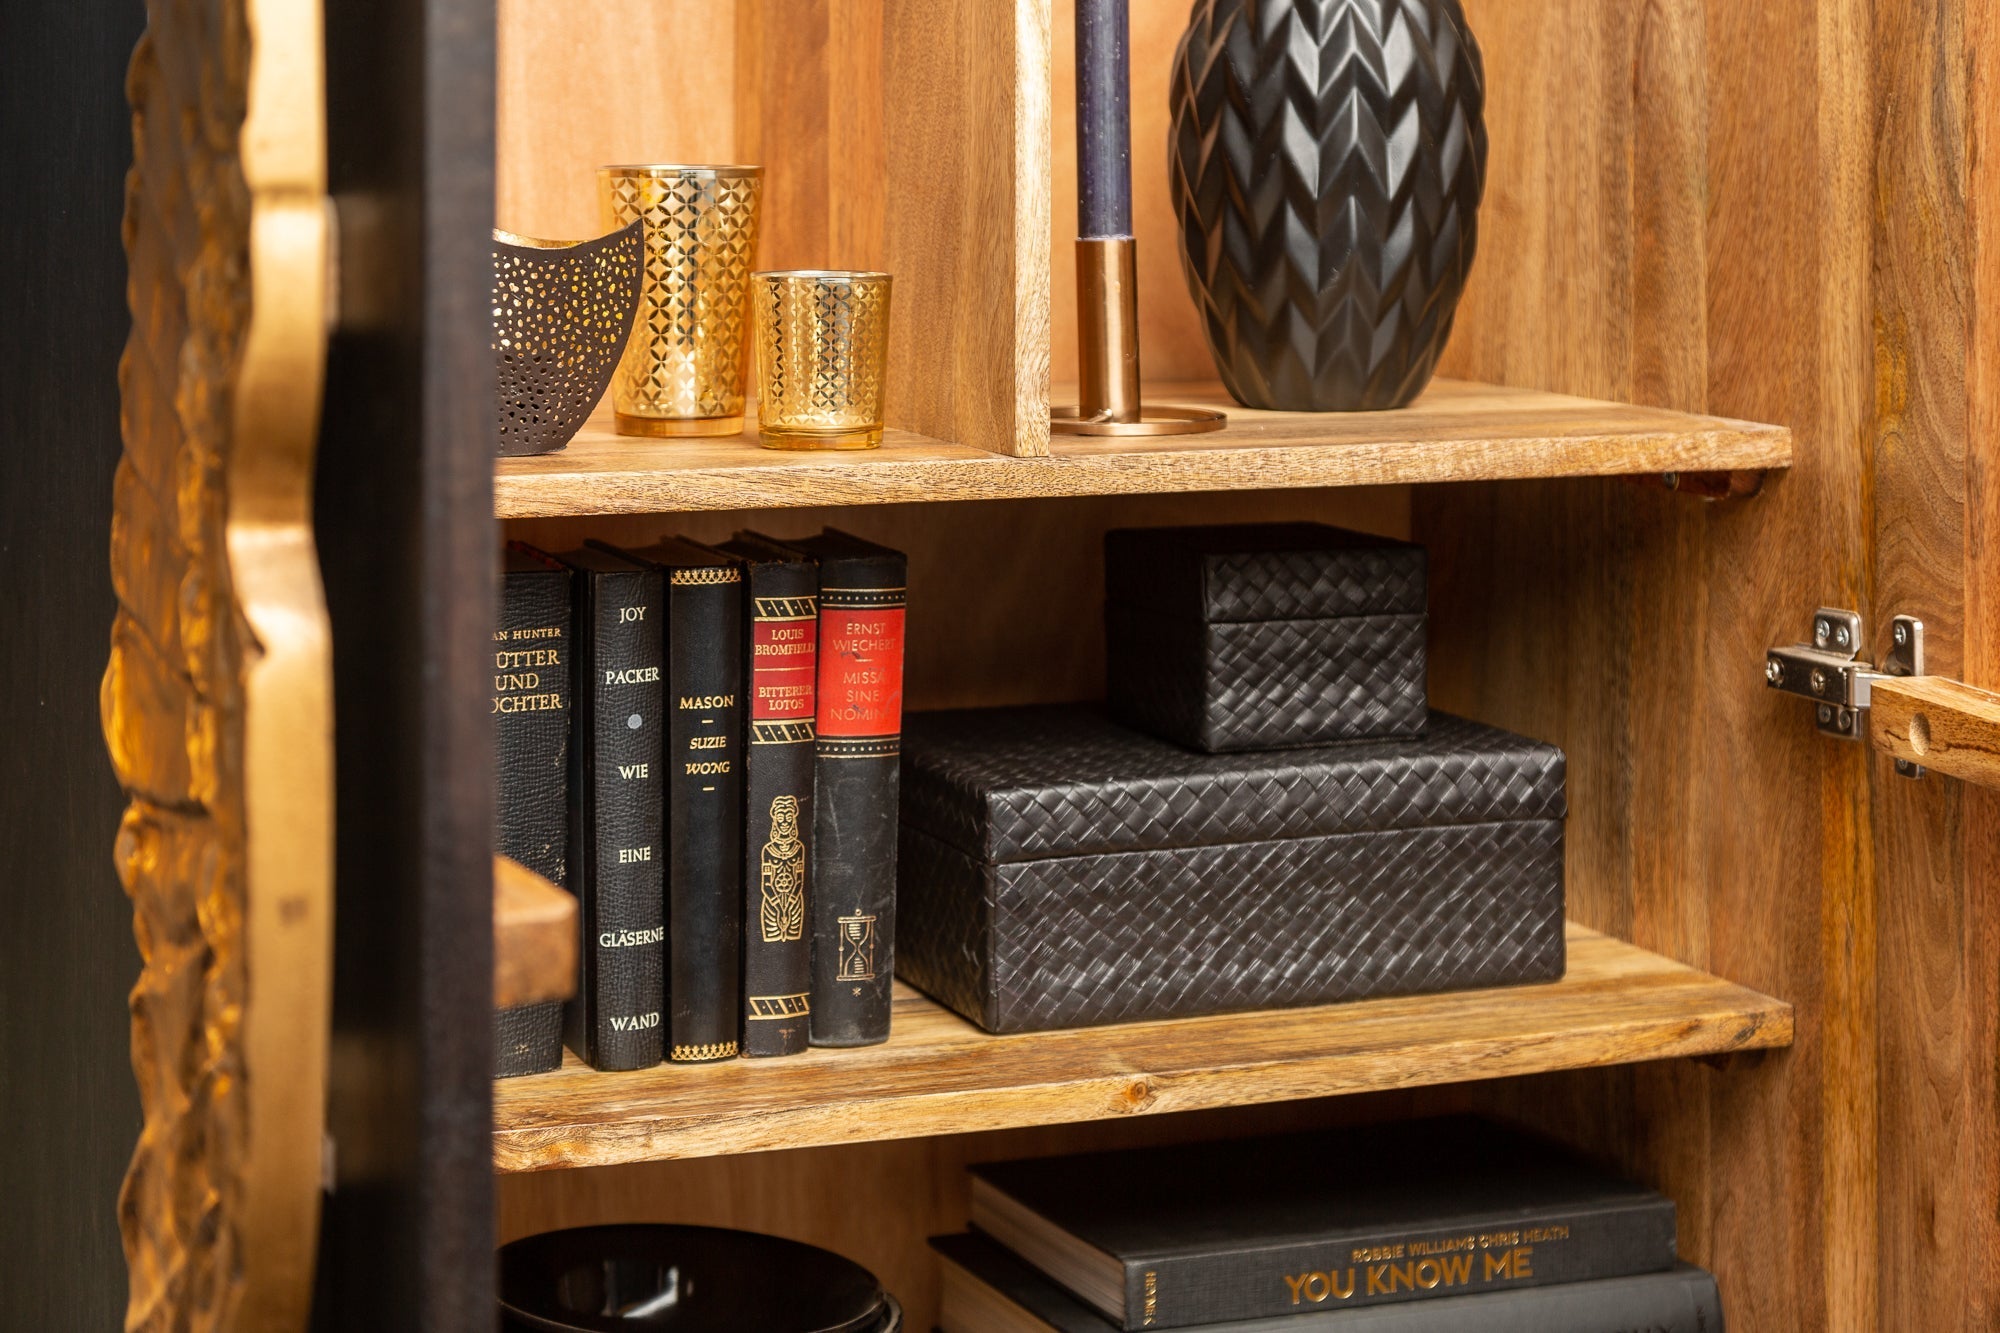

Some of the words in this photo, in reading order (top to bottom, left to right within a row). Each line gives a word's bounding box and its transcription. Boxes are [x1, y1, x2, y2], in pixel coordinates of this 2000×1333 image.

[619, 606, 647, 624] JOY
[492, 630, 508, 641] AN
[512, 627, 562, 640] HUNTER
[771, 628, 804, 641] LOUIS
[846, 622, 886, 635] ERNST
[754, 643, 816, 656] BROMFIELD
[832, 638, 896, 652] WIECHERT
[495, 649, 561, 669] ÜTTER
[494, 672, 540, 691] UND
[605, 667, 660, 685] PACKER
[758, 685, 813, 698] BITTERER
[846, 690, 880, 703] SINE
[490, 693, 563, 713] ÖCHTER
[679, 695, 735, 710] MASON
[768, 699, 805, 711] LOTOS
[689, 735, 727, 750] SUZIE
[618, 763, 649, 779] WIE
[685, 760, 731, 775] WONG
[619, 846, 651, 863] EINE
[599, 926, 665, 948] GLÄSERNE
[610, 1012, 660, 1031] WAND
[1352, 1244, 1405, 1263] ROBBIE
[1408, 1235, 1475, 1258] WILLIAMS
[1478, 1231, 1520, 1249] CHRIS
[1523, 1226, 1569, 1244] HEATH
[1284, 1268, 1355, 1305] YOU
[1367, 1254, 1475, 1296] KNOW
[1484, 1246, 1534, 1282] ME
